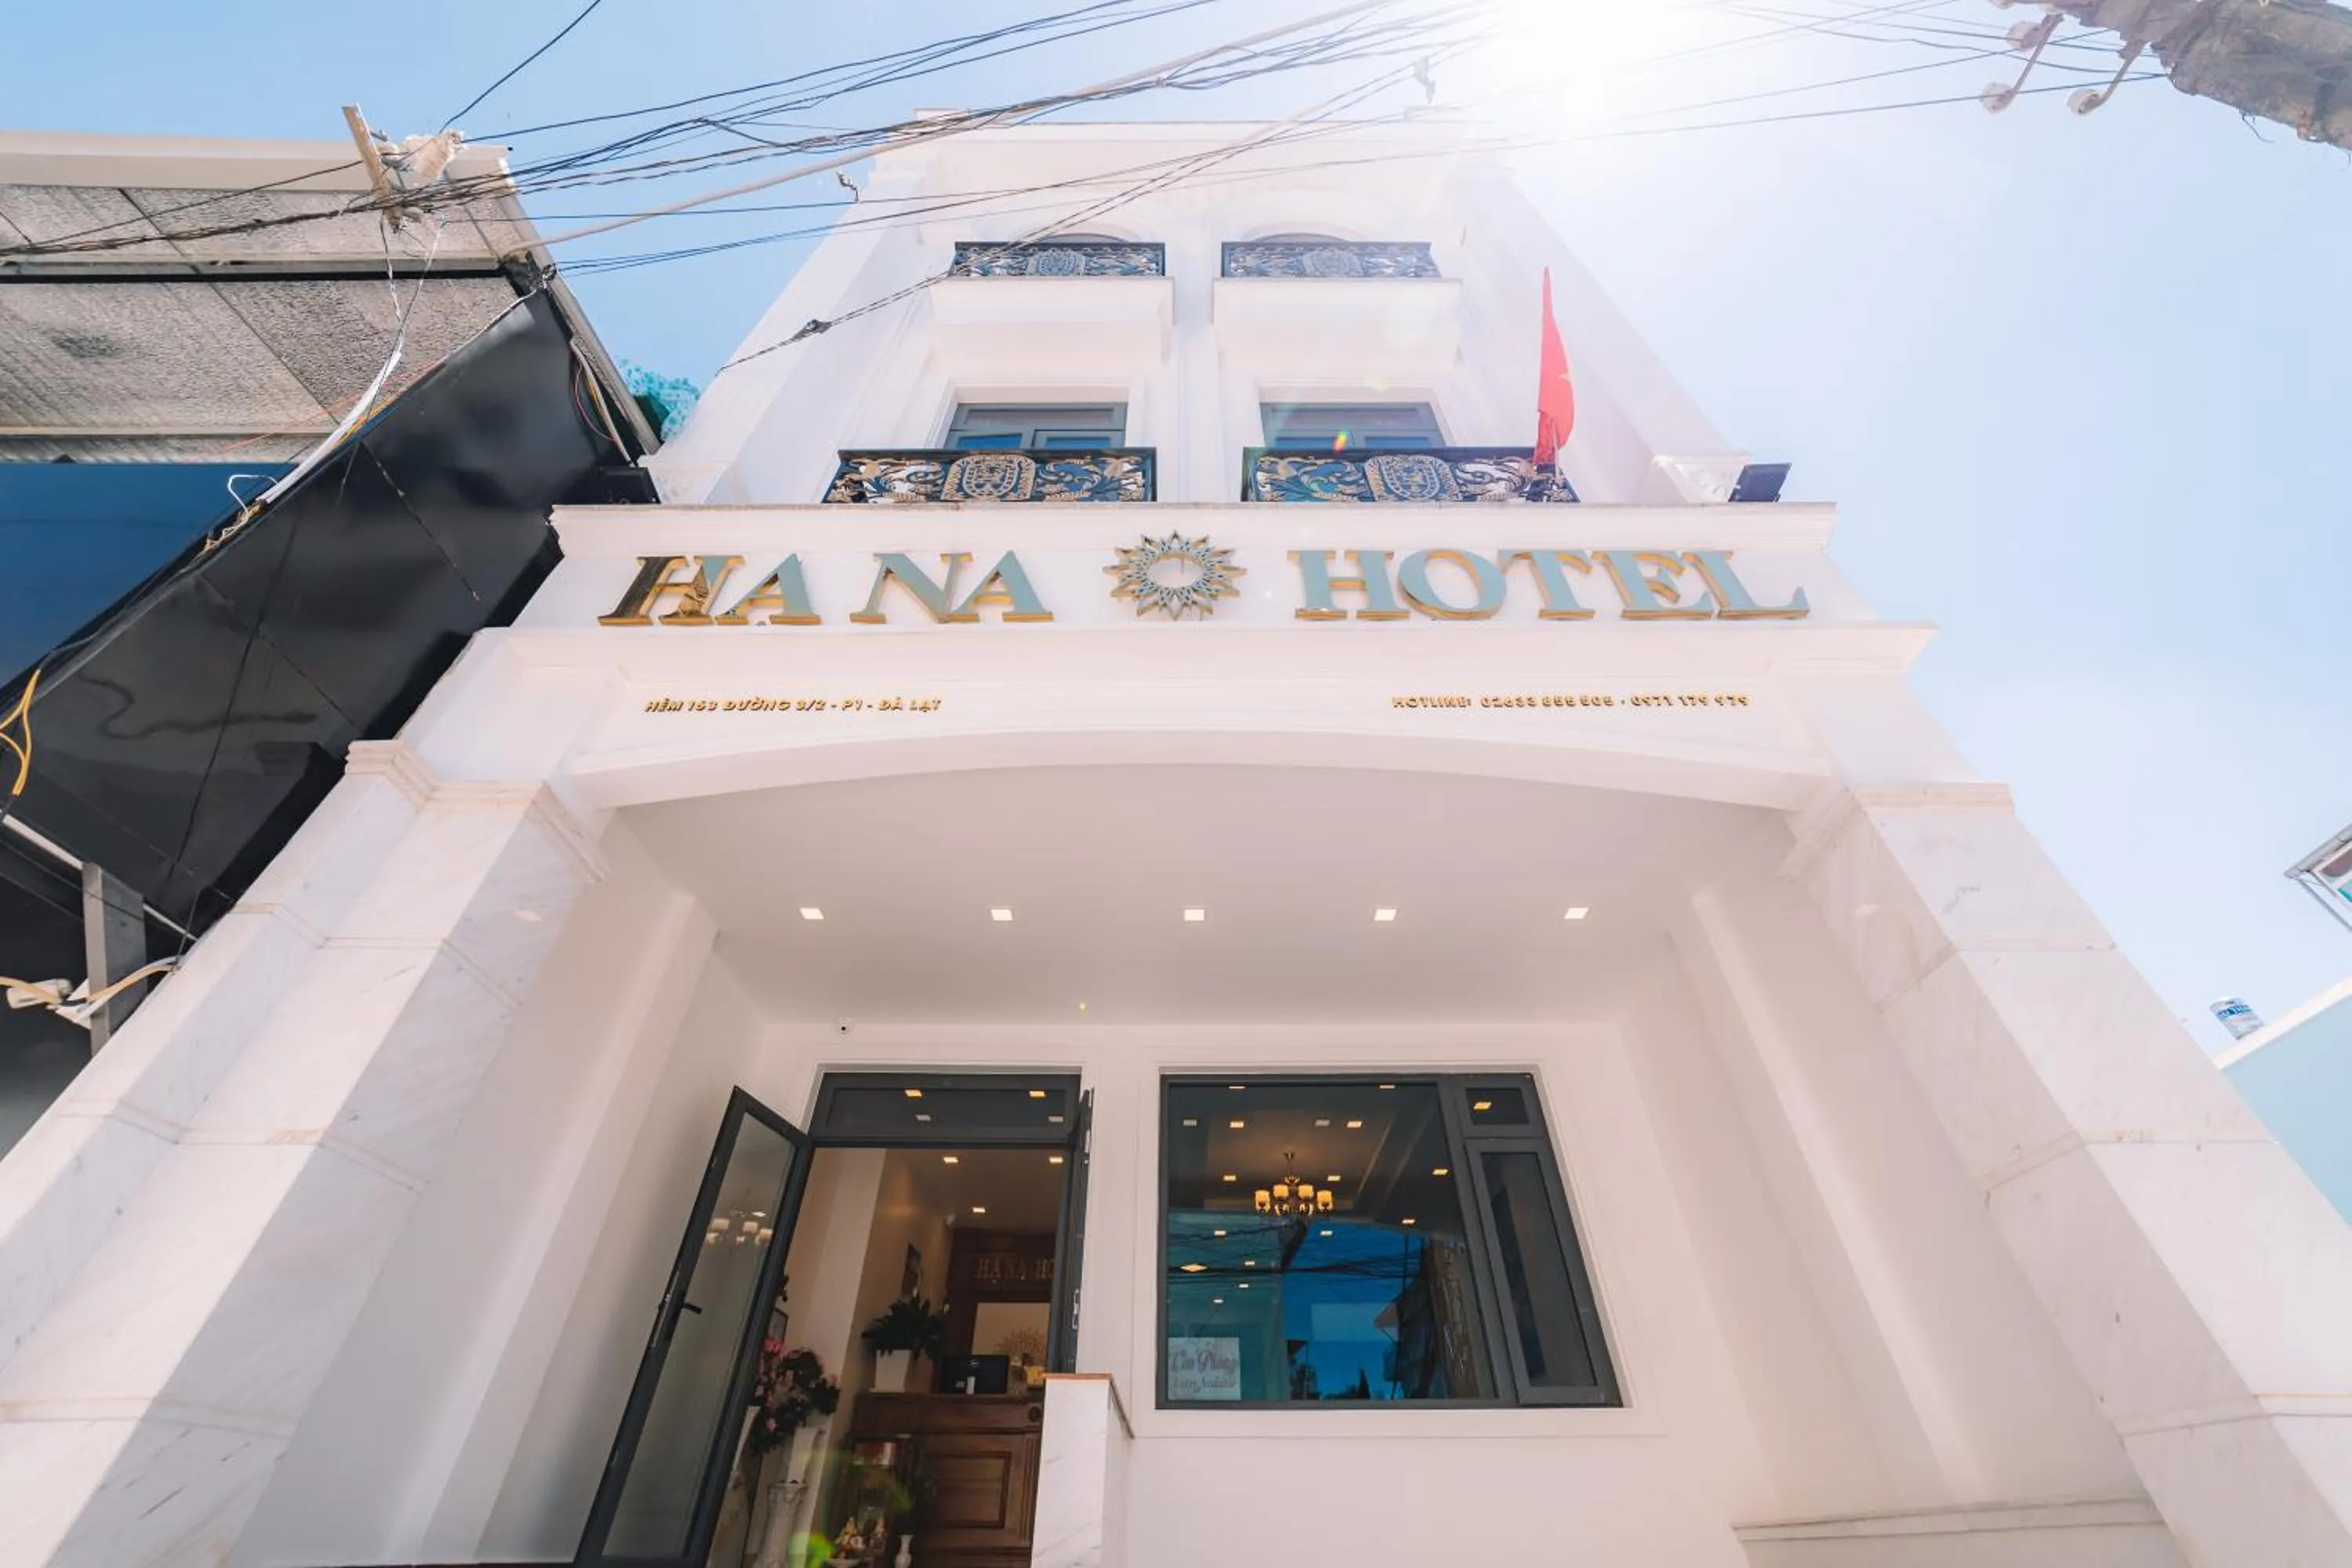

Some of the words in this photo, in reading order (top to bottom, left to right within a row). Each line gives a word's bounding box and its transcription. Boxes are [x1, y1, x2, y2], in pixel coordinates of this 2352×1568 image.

[1287, 549, 1810, 621] HOTEL
[796, 699, 827, 711] 3/2
[841, 699, 864, 711] P1
[1630, 695, 1675, 706] 0971
[1678, 695, 1710, 706] 179
[1714, 695, 1749, 706] 979
